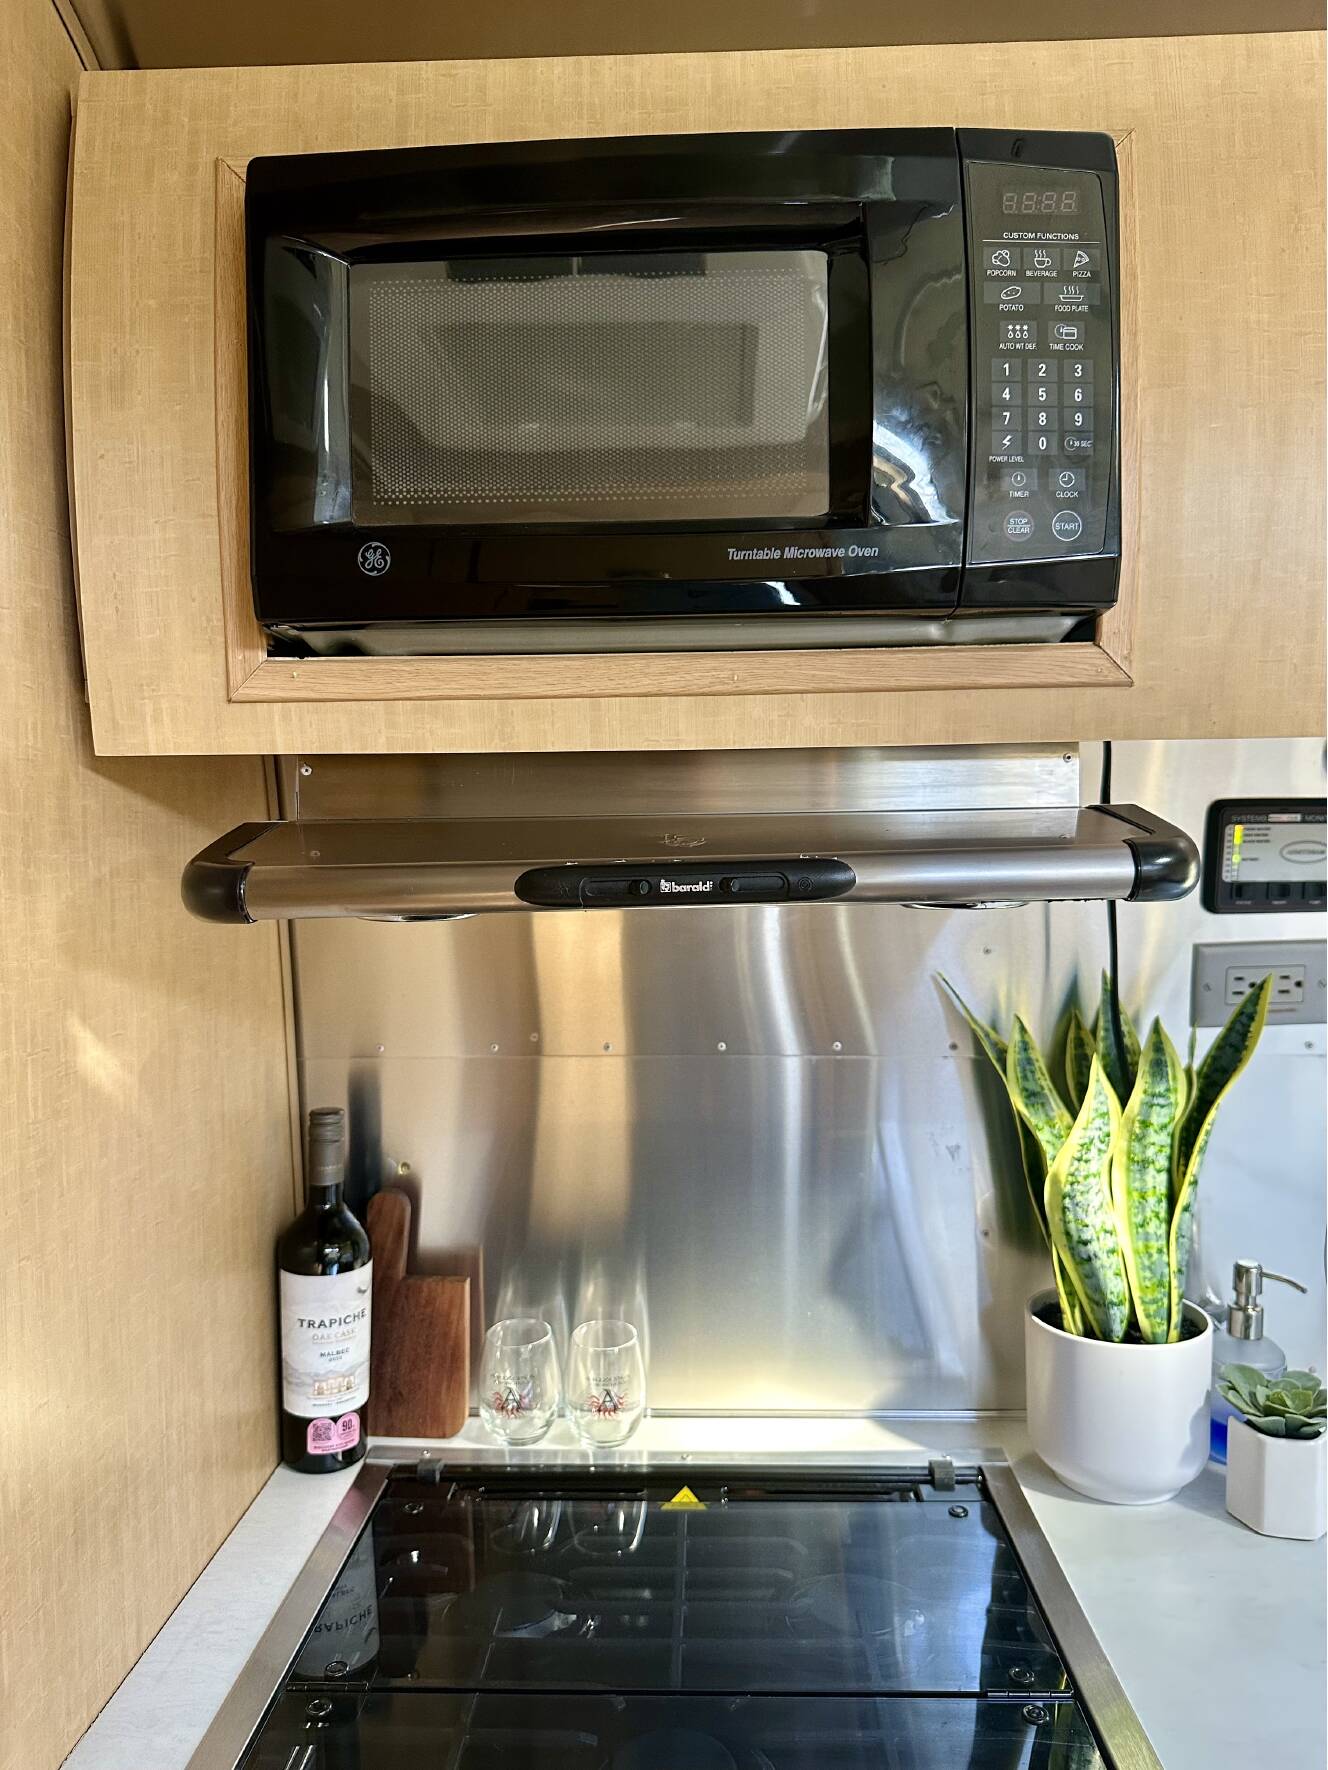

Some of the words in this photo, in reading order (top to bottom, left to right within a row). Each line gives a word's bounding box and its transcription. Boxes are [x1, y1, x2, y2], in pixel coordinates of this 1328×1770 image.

[1003, 232, 1036, 240] CUSTOM
[1037, 232, 1079, 240] FUNCTIONS
[987, 269, 1017, 277] POPCORN
[1003, 363, 1010, 376] 1
[1038, 363, 1047, 377] 2
[1074, 364, 1082, 377] 3
[1002, 388, 1010, 401] 4
[1038, 388, 1046, 401] 5
[1074, 388, 1082, 402] 6
[1002, 412, 1011, 425] 7
[1038, 412, 1047, 425] 8
[1074, 413, 1083, 426] 9
[1038, 437, 1047, 450] 0
[1080, 440, 1093, 448] SEC
[989, 455, 1009, 463] POWER
[1009, 455, 1024, 463] LEVEL
[1008, 526, 1030, 534] CLEAR
[1055, 522, 1079, 530] START
[727, 547, 781, 560] Turntable
[783, 546, 845, 559] Microwave
[848, 544, 879, 557] Oven
[297, 1308, 367, 1329] TRAPICHE
[320, 1347, 351, 1358] MALBEC
[342, 1418, 353, 1432] 90
